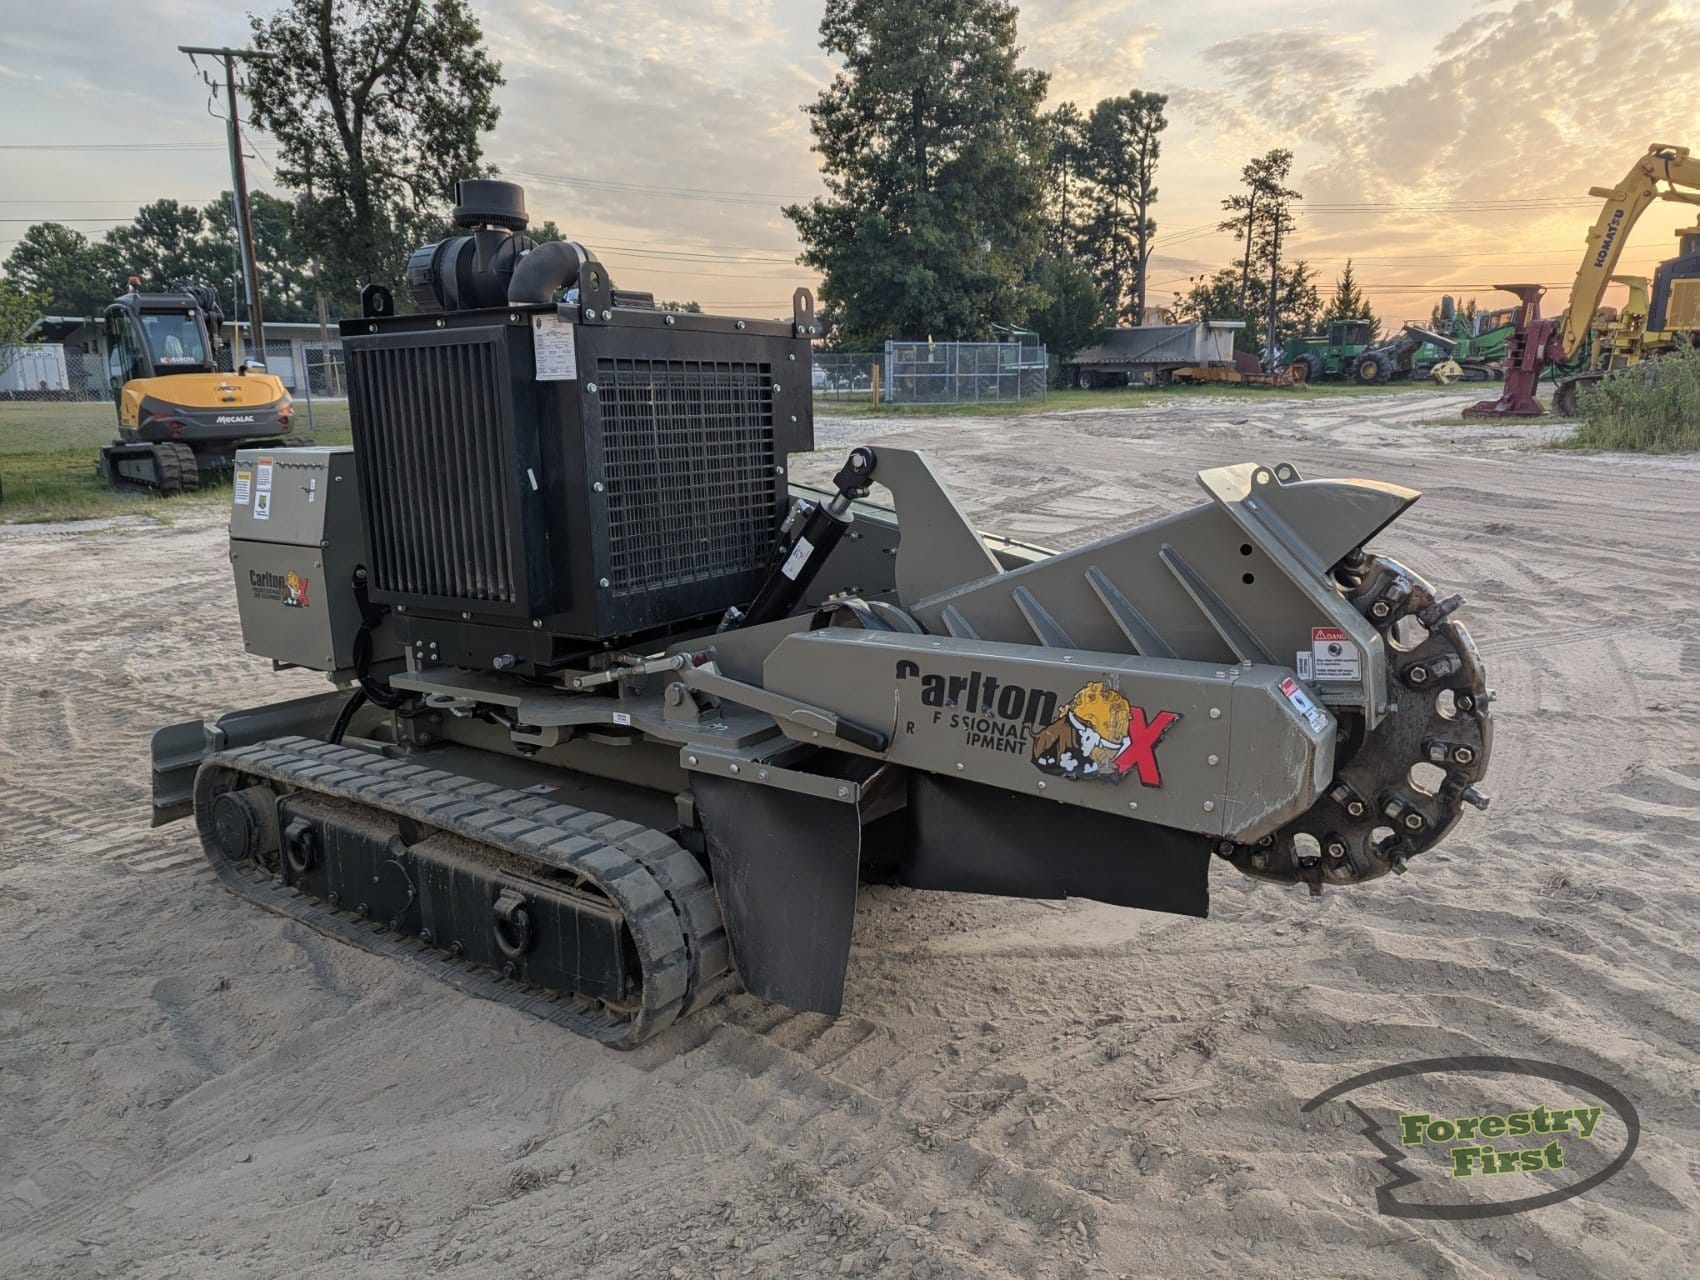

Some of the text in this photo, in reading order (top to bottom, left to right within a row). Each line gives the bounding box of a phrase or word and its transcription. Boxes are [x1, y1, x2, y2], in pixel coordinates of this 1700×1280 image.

[1594, 209, 1624, 267] KOMATSU
[216, 415, 254, 424] MECALAC
[249, 569, 285, 590] Carlton
[966, 732, 1027, 756] IPMENT
